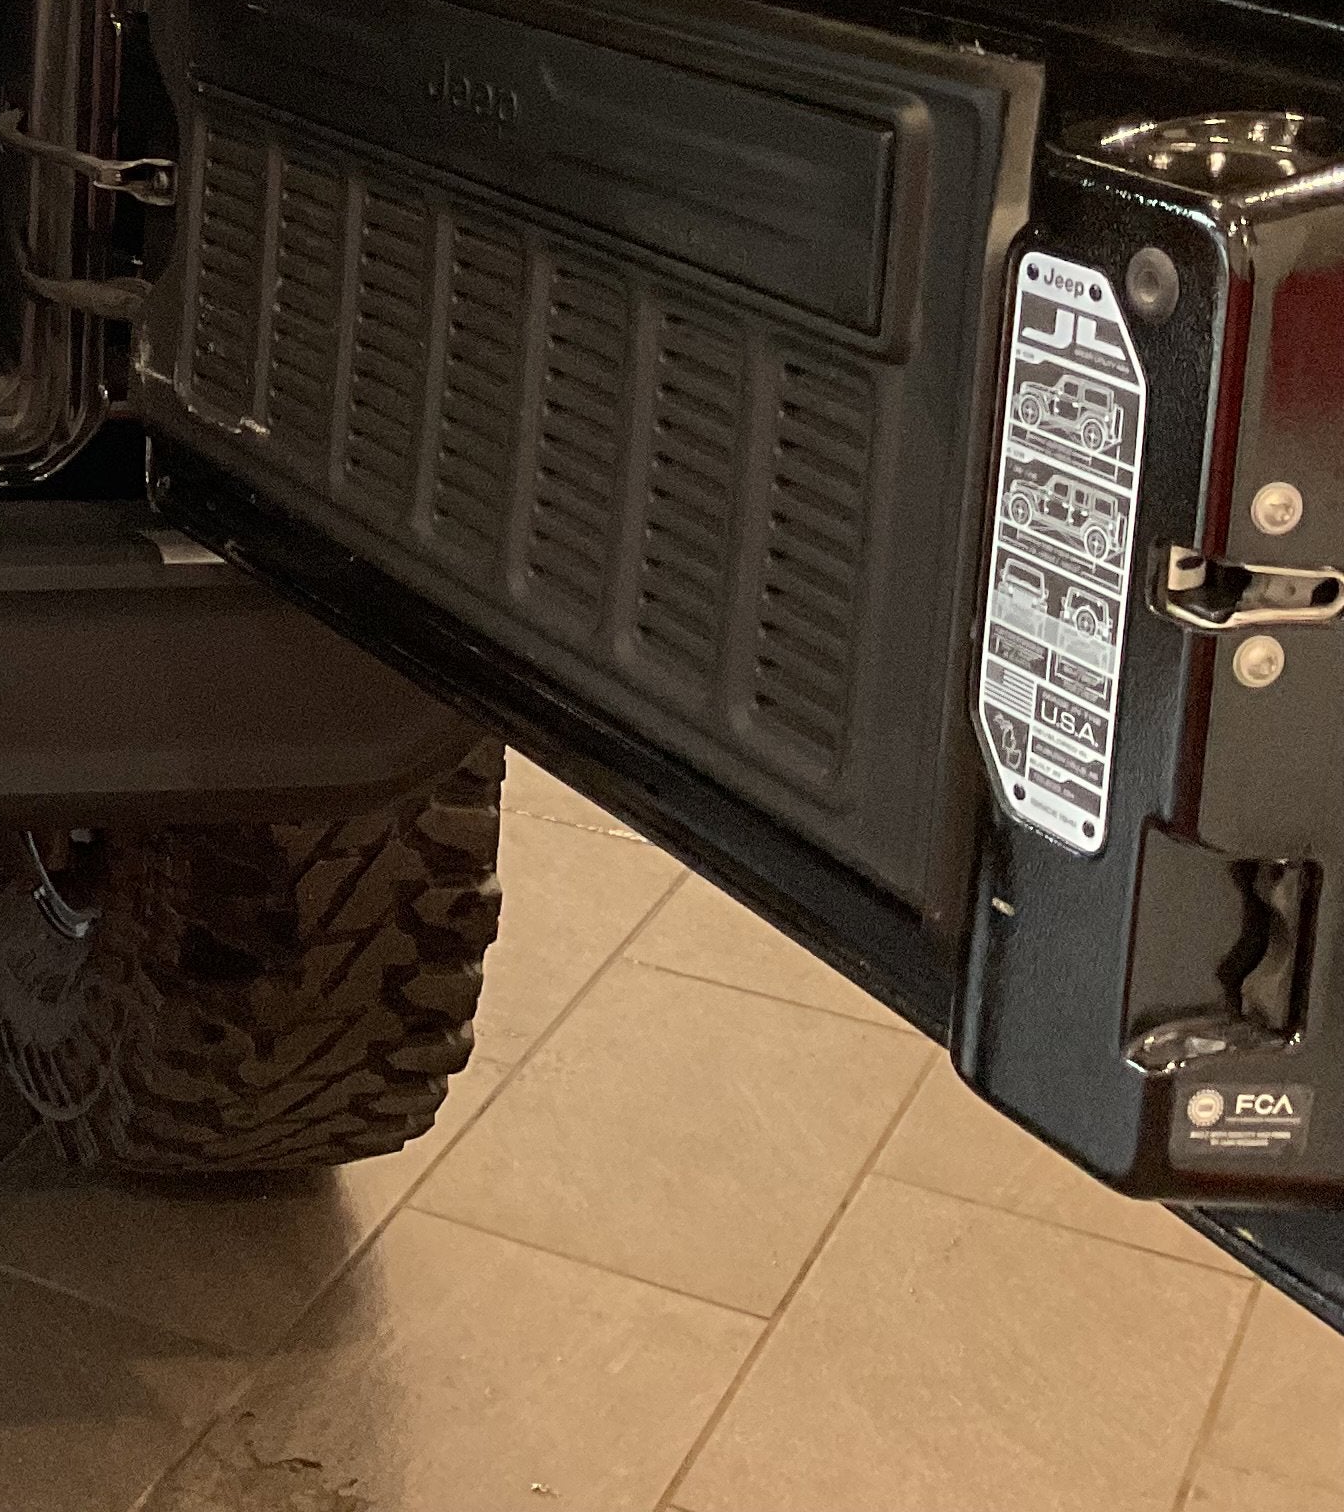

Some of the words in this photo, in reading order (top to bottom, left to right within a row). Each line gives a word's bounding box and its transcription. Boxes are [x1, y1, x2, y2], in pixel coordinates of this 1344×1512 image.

[1043, 267, 1085, 298] Jeep
[1021, 308, 1127, 361] JL
[1040, 699, 1099, 748] U.S.A.
[1235, 1094, 1293, 1115] FCA
